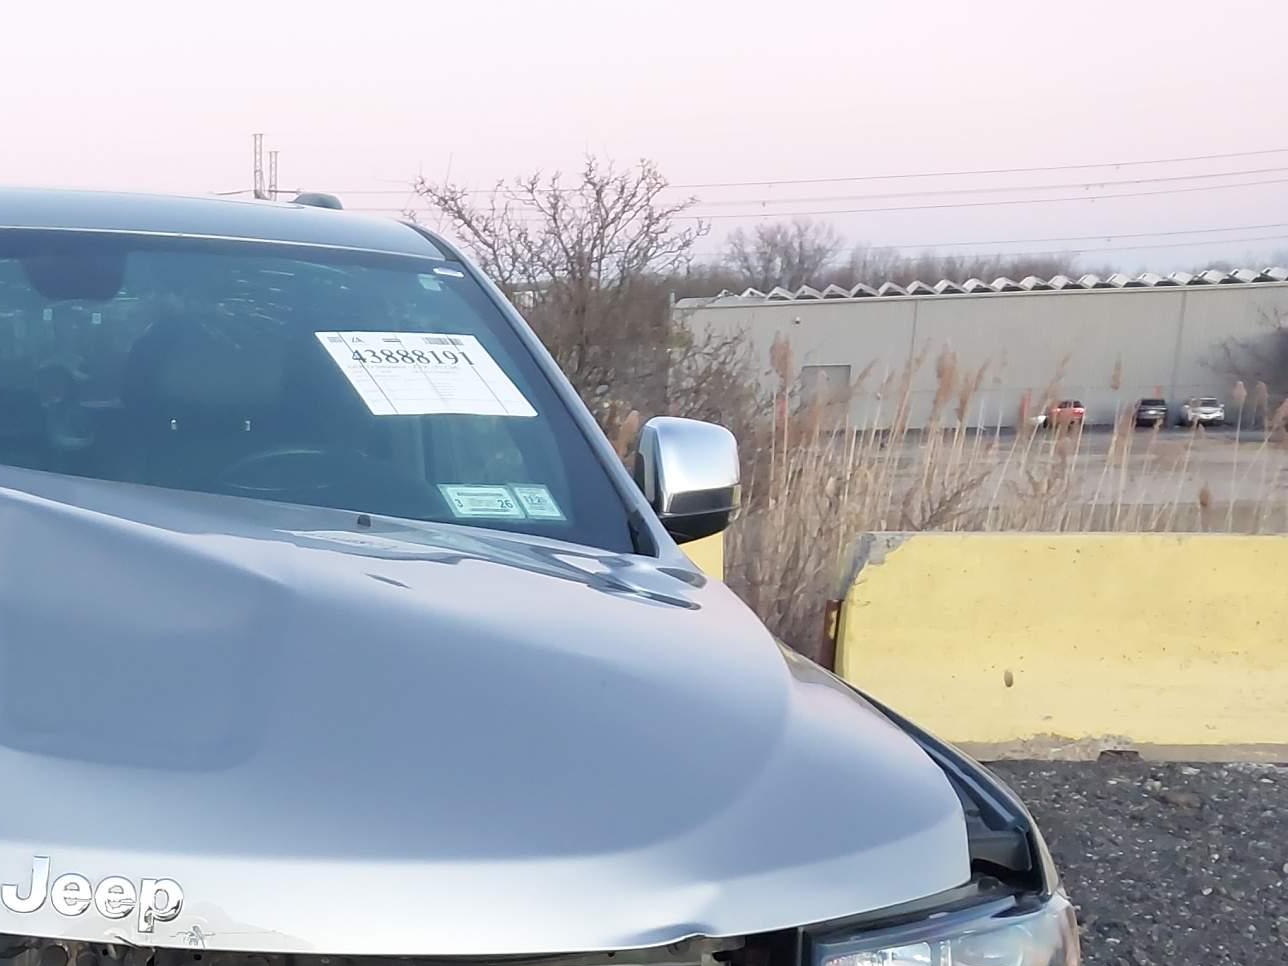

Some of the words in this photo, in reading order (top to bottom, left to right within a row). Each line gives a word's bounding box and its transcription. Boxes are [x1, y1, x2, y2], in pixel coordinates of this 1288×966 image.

[352, 348, 475, 367] 43888191
[496, 499, 515, 509] 26
[0, 854, 185, 934] Jeep
